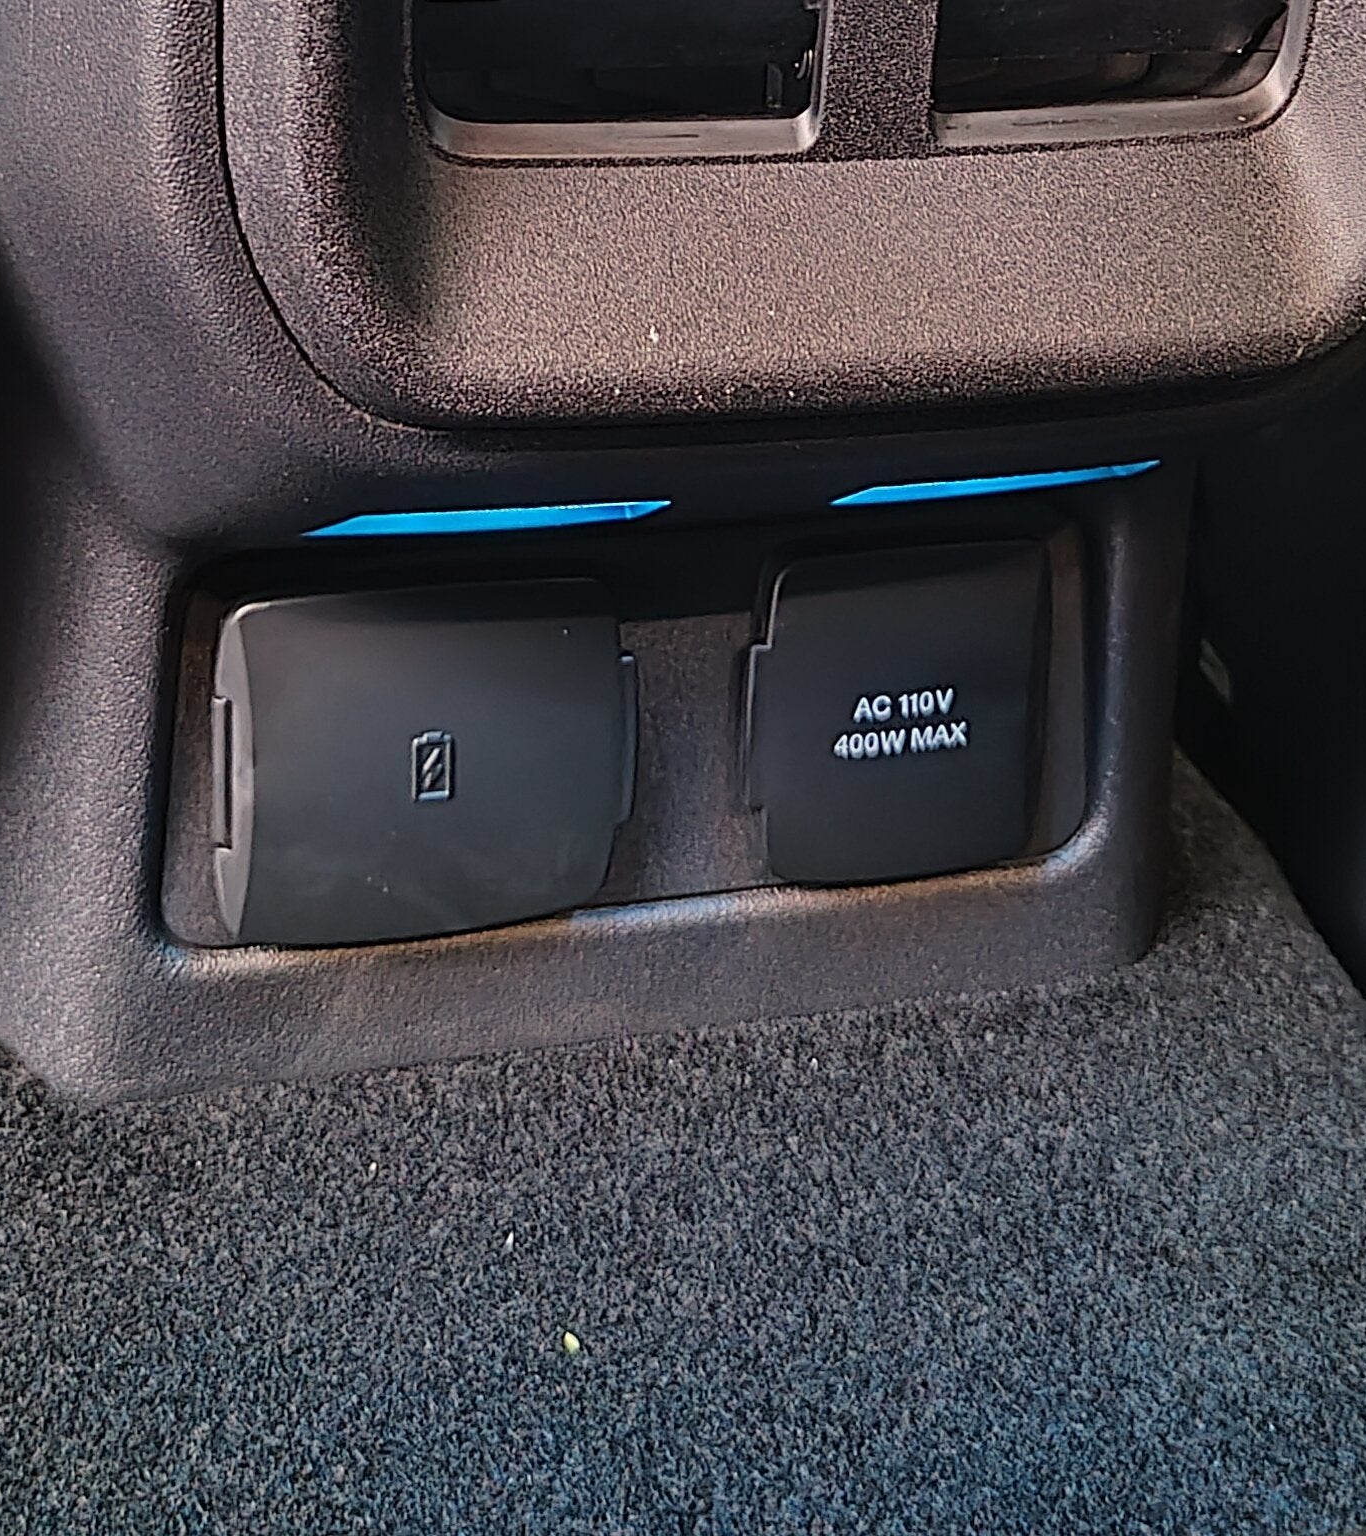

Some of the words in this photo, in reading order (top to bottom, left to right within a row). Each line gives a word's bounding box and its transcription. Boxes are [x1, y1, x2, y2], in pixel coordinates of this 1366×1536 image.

[852, 694, 892, 723] AC
[898, 687, 954, 719] 110V
[833, 728, 906, 759] 400W
[910, 721, 967, 753] MAX
